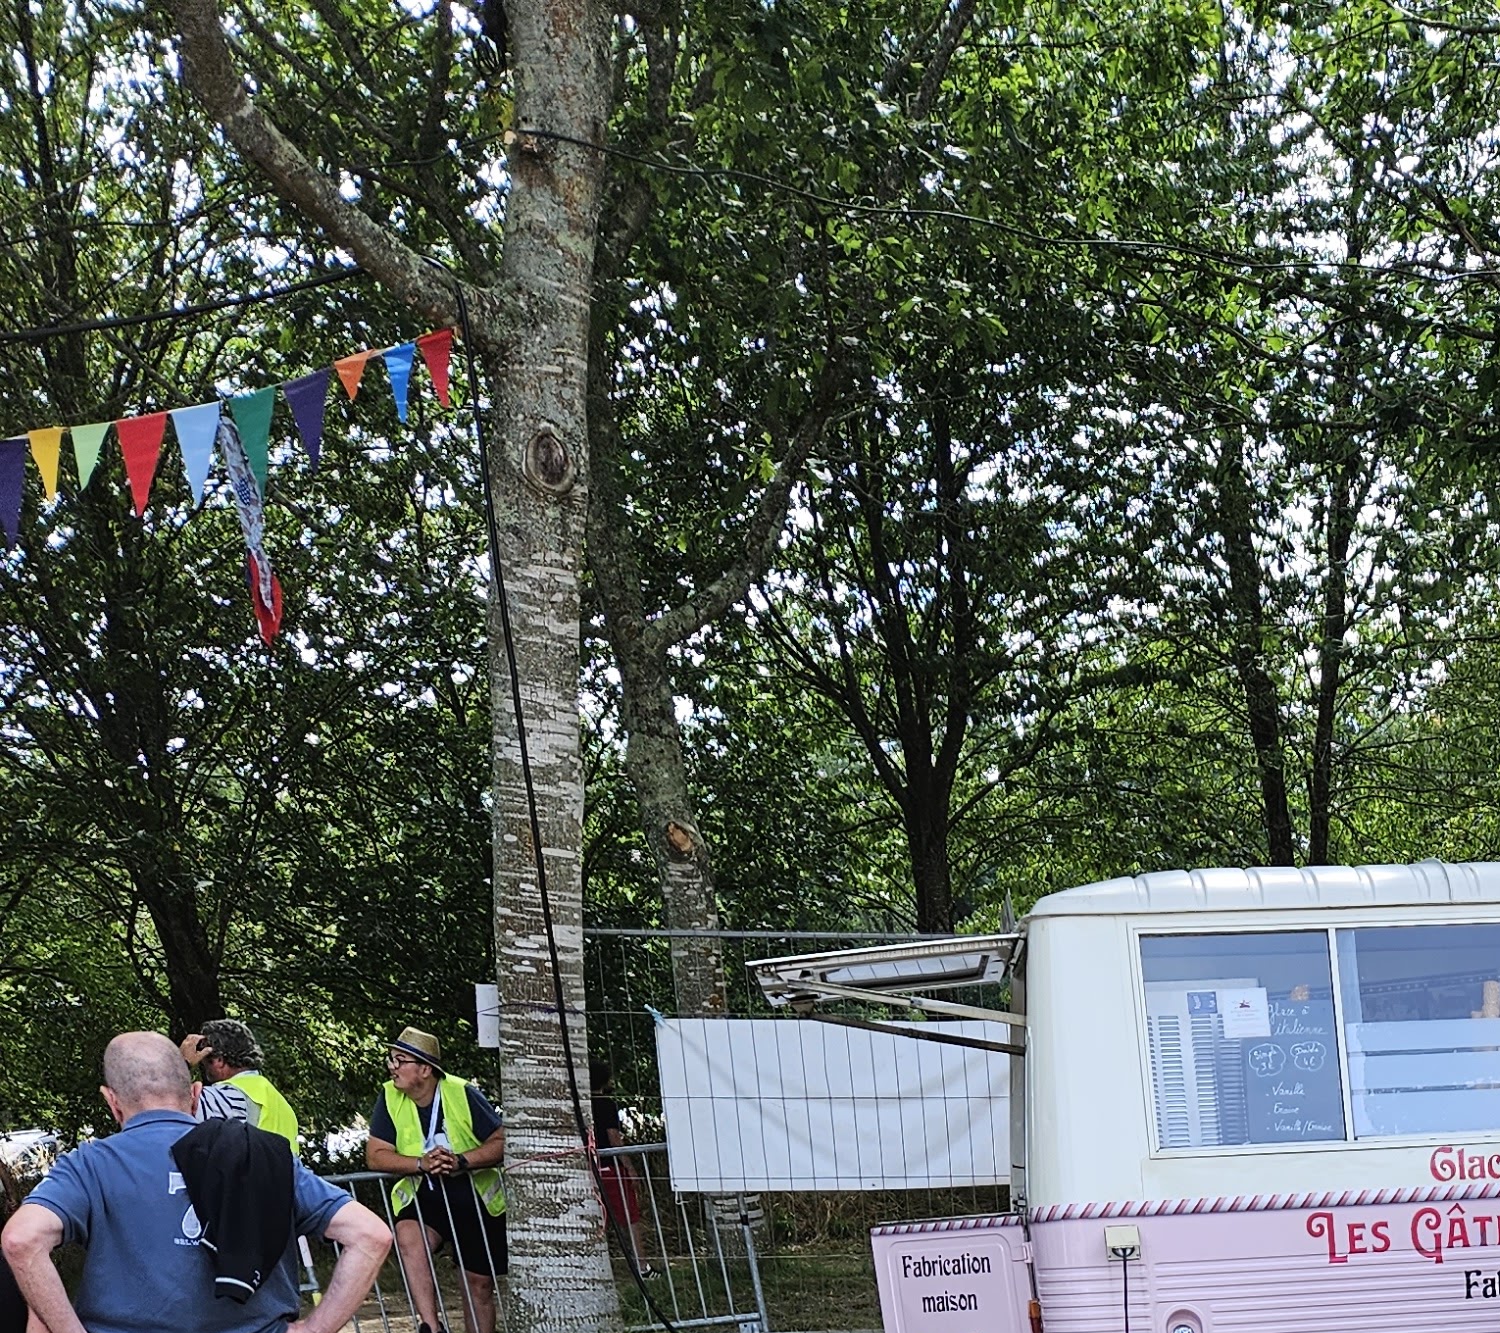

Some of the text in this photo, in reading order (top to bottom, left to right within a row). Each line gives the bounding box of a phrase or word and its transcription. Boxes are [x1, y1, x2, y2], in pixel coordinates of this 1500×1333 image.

[1306, 1212, 1391, 1264] LES
[902, 1253, 991, 1278] Fabrication
[922, 1290, 978, 1313] maison
